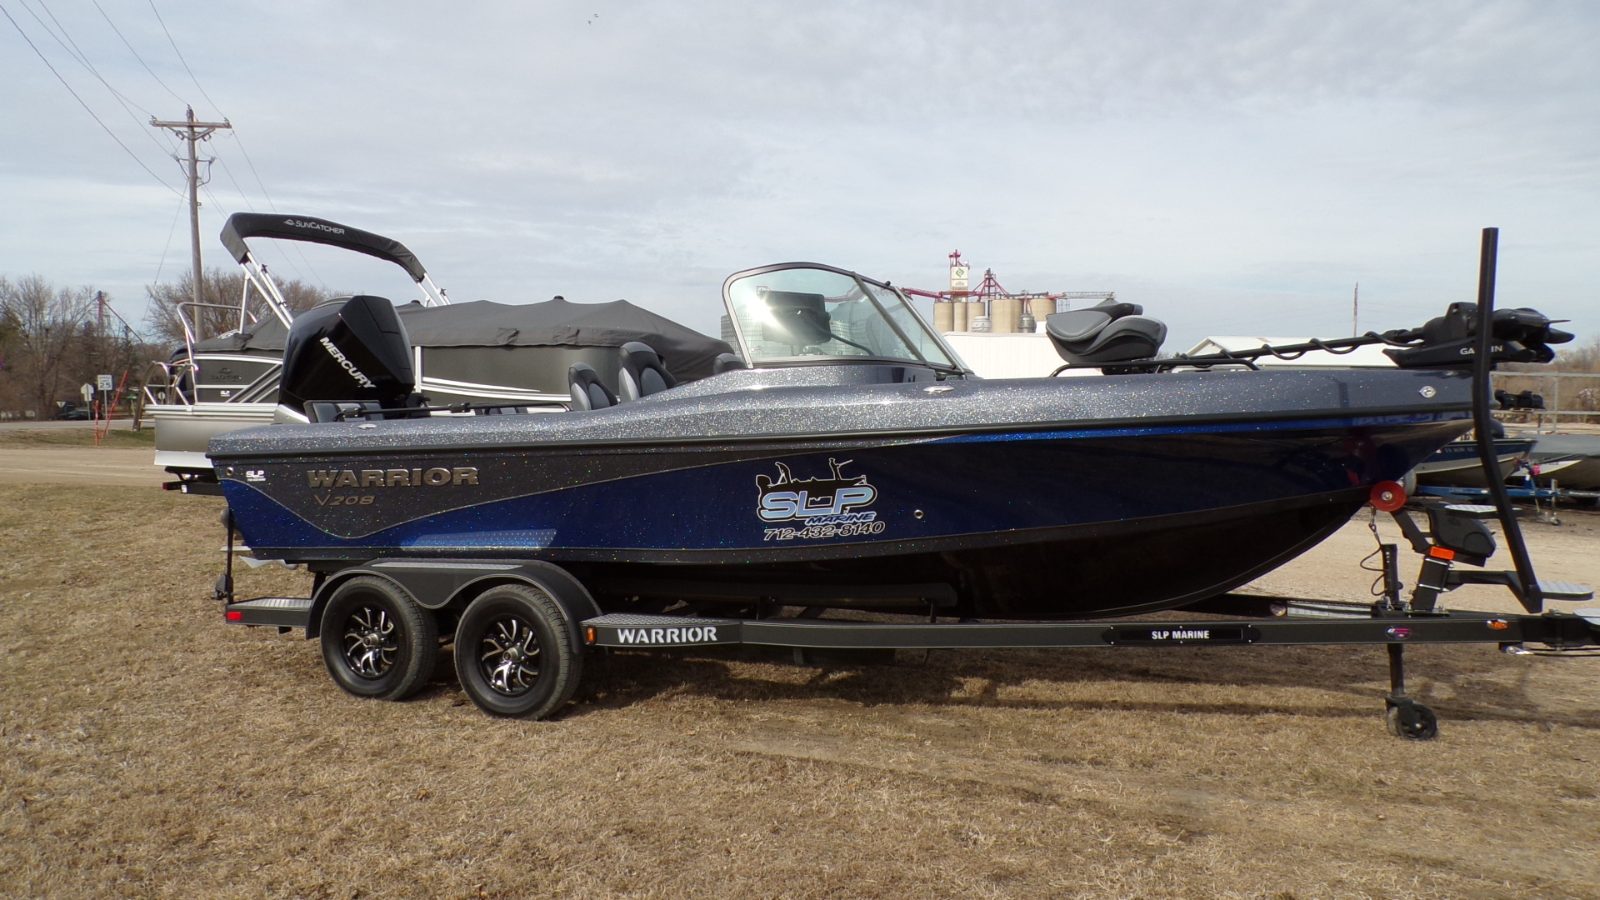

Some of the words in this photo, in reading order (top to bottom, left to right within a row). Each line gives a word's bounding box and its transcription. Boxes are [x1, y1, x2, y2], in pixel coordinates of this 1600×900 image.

[1460, 345, 1503, 355] GAIN
[320, 337, 376, 389] MERCURY
[307, 467, 479, 488] WARRIOR
[313, 494, 375, 506] V208
[760, 486, 876, 519] SLP
[805, 511, 877, 525] MARINE
[764, 521, 885, 540] 712-432-8140
[617, 626, 717, 643] WARRIOR
[1151, 630, 1169, 639] SLP
[1172, 630, 1210, 639] MARINE
